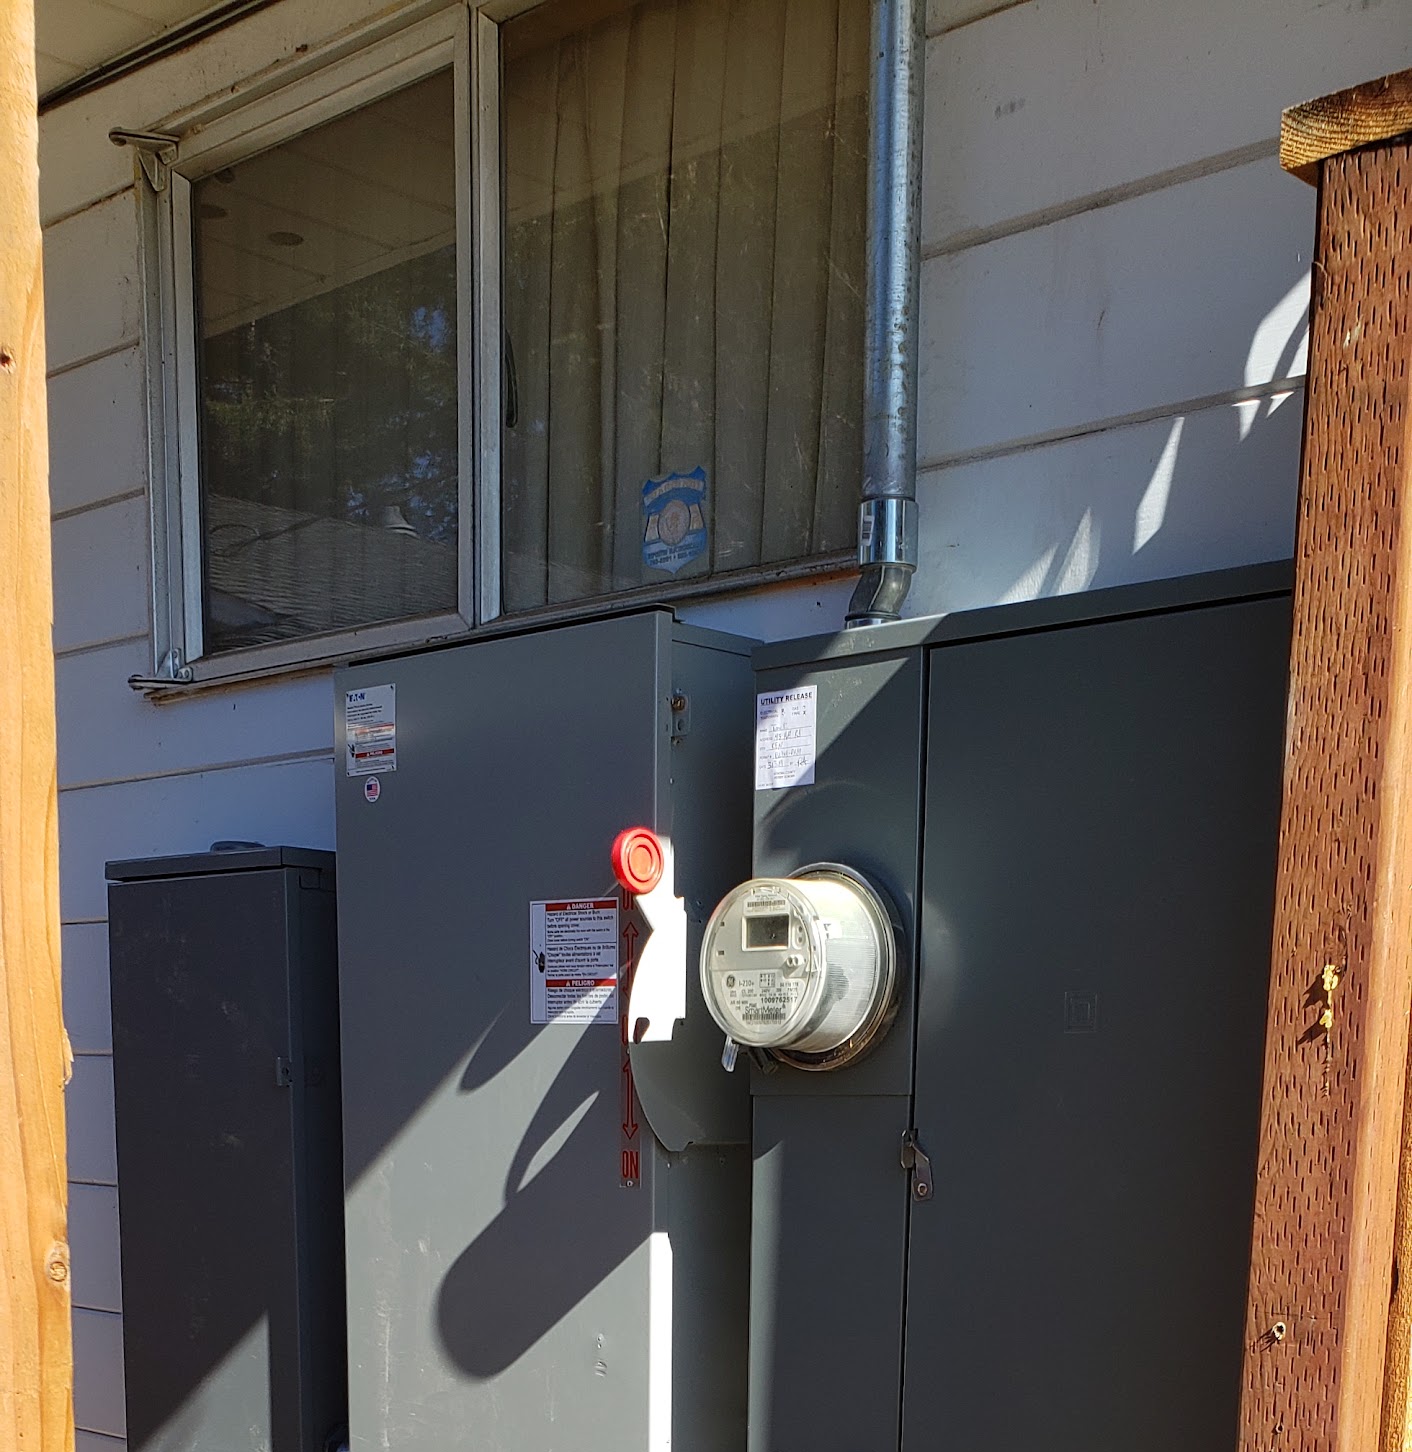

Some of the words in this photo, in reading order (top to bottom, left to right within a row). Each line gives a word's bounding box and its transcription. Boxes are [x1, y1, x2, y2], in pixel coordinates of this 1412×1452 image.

[760, 696, 784, 705] UTILITY
[785, 692, 813, 702] RELEASE
[571, 902, 595, 910] DANGER
[622, 1150, 639, 1179] ON
